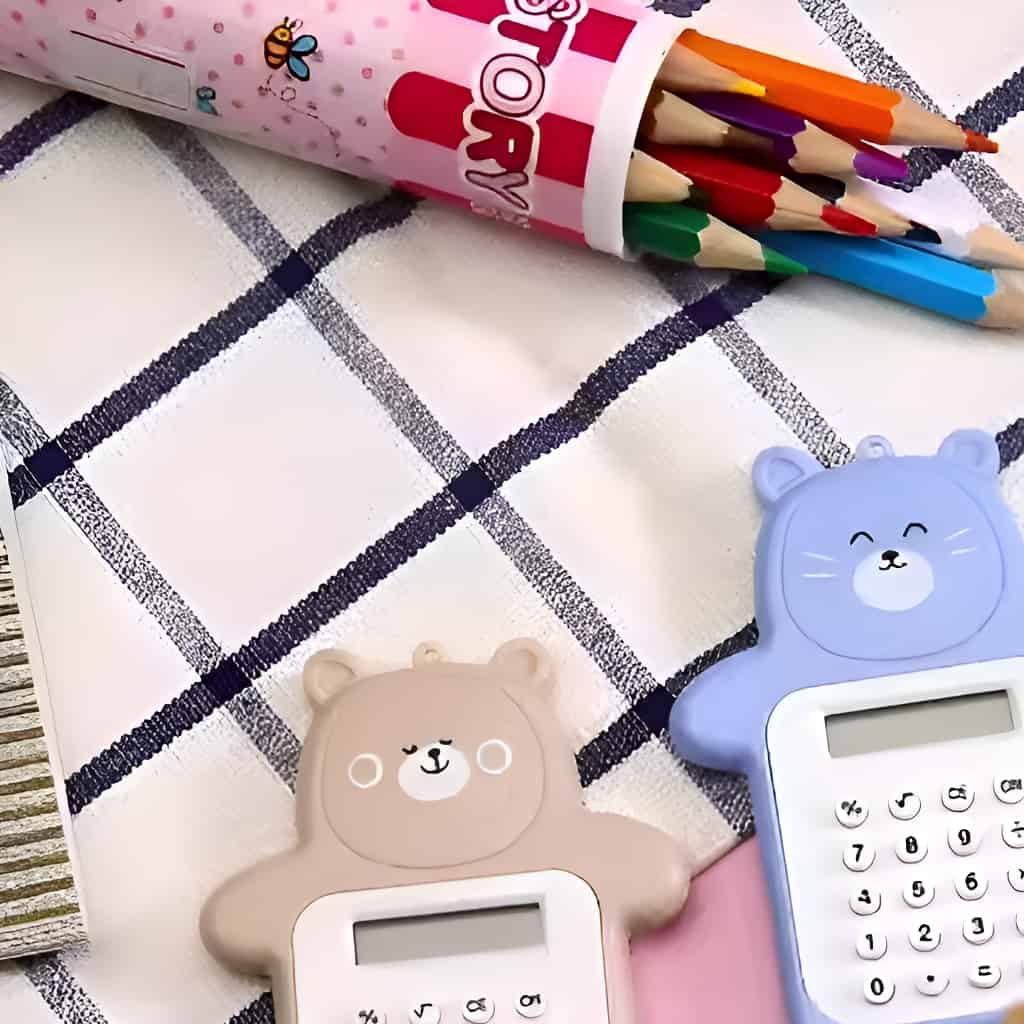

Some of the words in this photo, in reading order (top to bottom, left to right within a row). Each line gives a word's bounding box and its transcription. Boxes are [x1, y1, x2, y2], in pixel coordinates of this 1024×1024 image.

[851, 843, 865, 863] 7
[964, 871, 979, 891] 6
[917, 923, 933, 942] 2
[870, 977, 885, 997] 0
